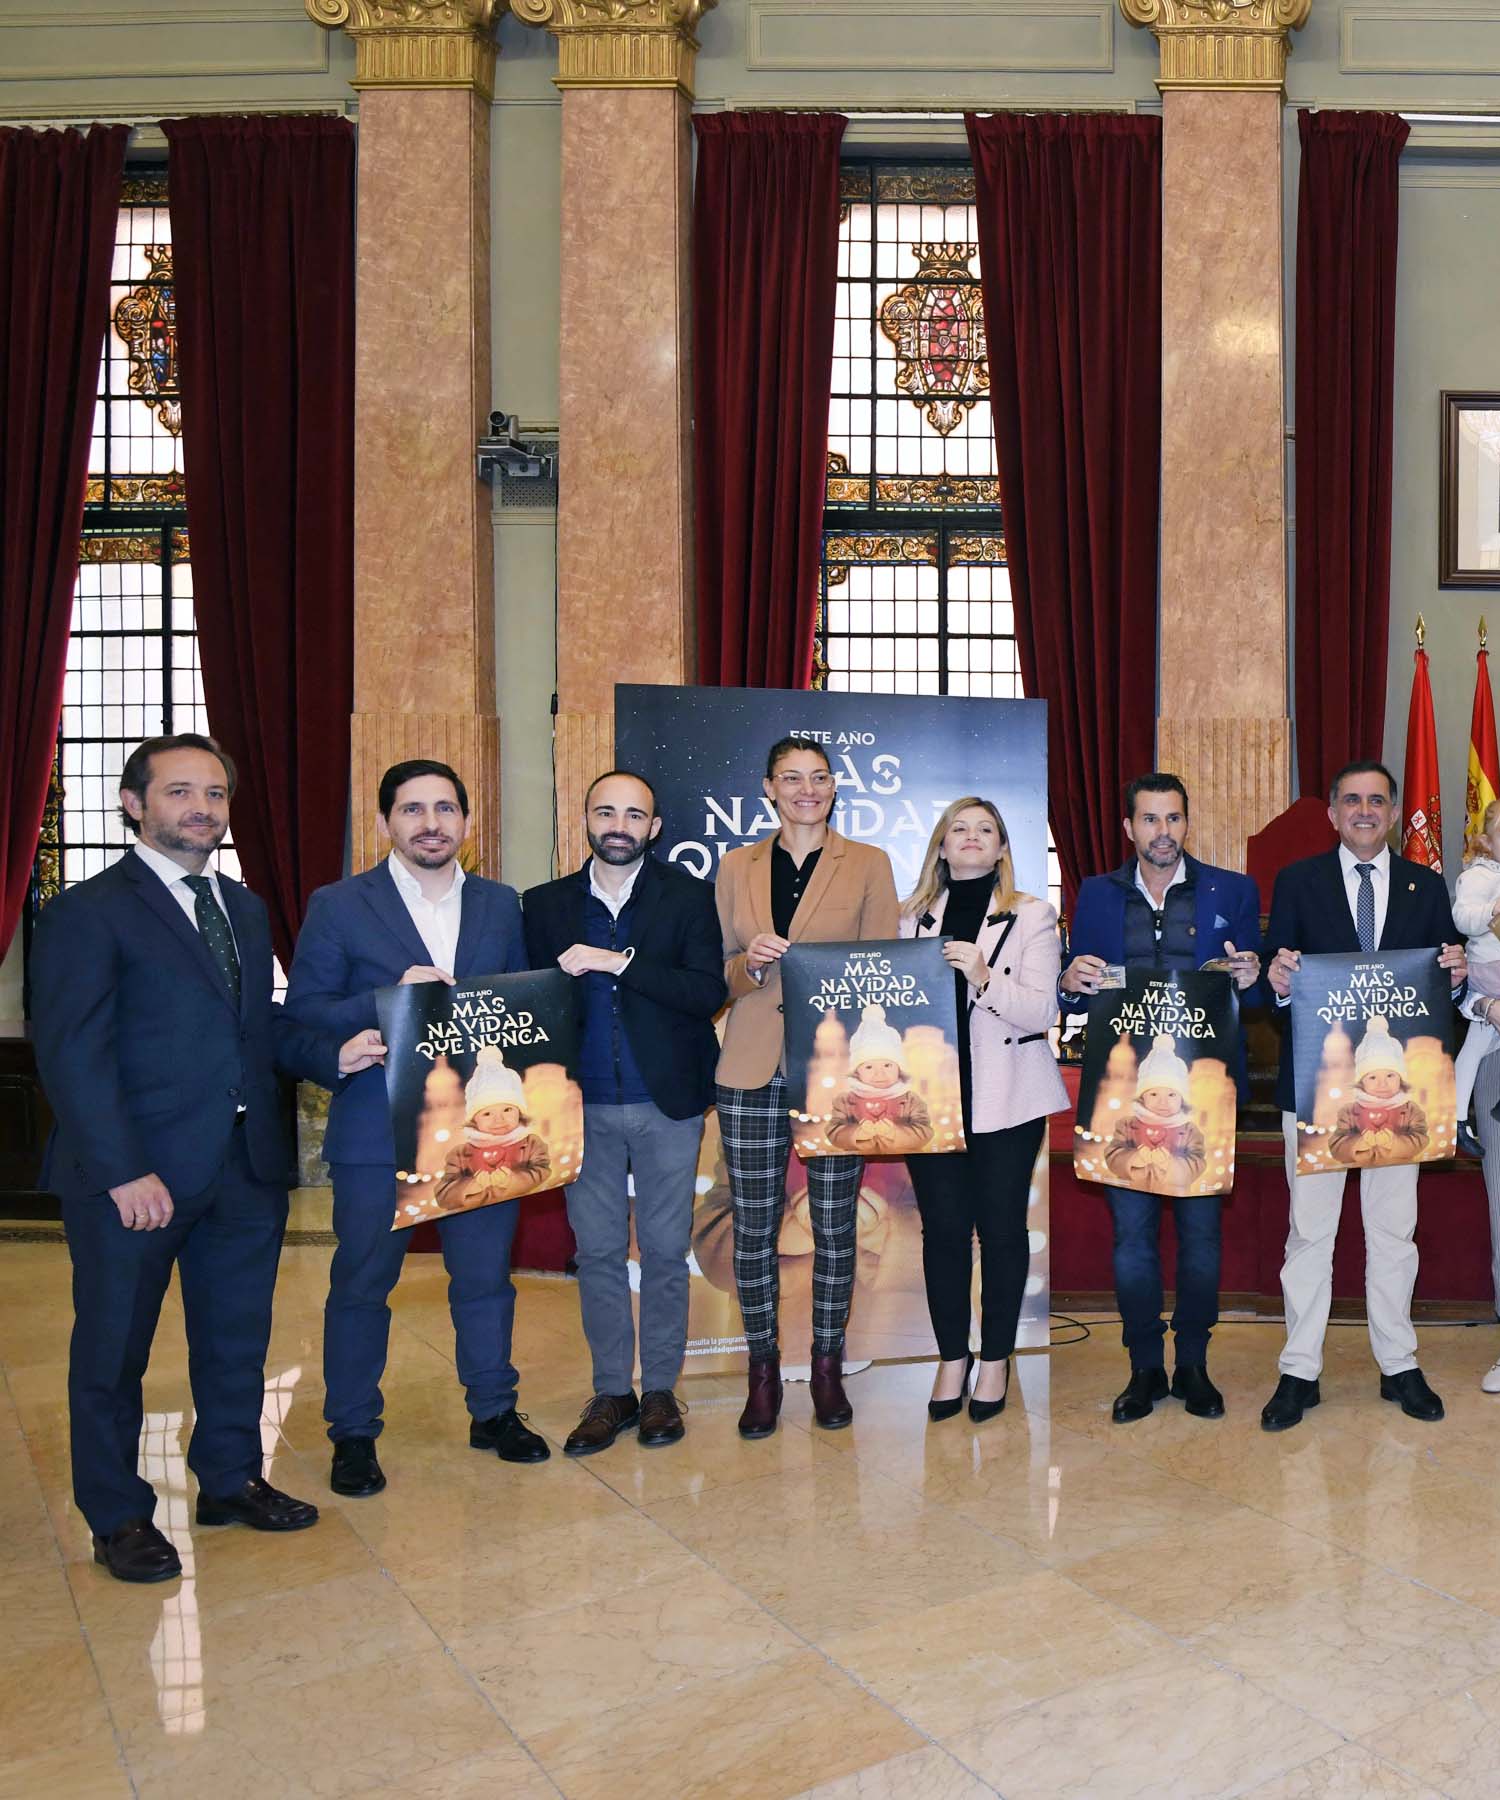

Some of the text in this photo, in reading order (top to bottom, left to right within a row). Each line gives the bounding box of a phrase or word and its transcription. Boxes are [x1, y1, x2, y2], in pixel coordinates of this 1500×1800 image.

[836, 731, 876, 745] AÑO
[835, 745, 902, 795] ÁS
[844, 958, 892, 977] MÁS
[1149, 980, 1163, 988] ESTE
[1350, 970, 1394, 989] MÁS
[457, 990, 475, 999] ESTE
[808, 990, 930, 1013] QUE NUNCA
[1142, 988, 1186, 1007] MÁS
[452, 996, 506, 1019] MÁS
[1317, 1001, 1430, 1024] QUE NUNCA
[1109, 1017, 1216, 1038] QUE NUNCA
[415, 1026, 550, 1061] QUE NUNCA
